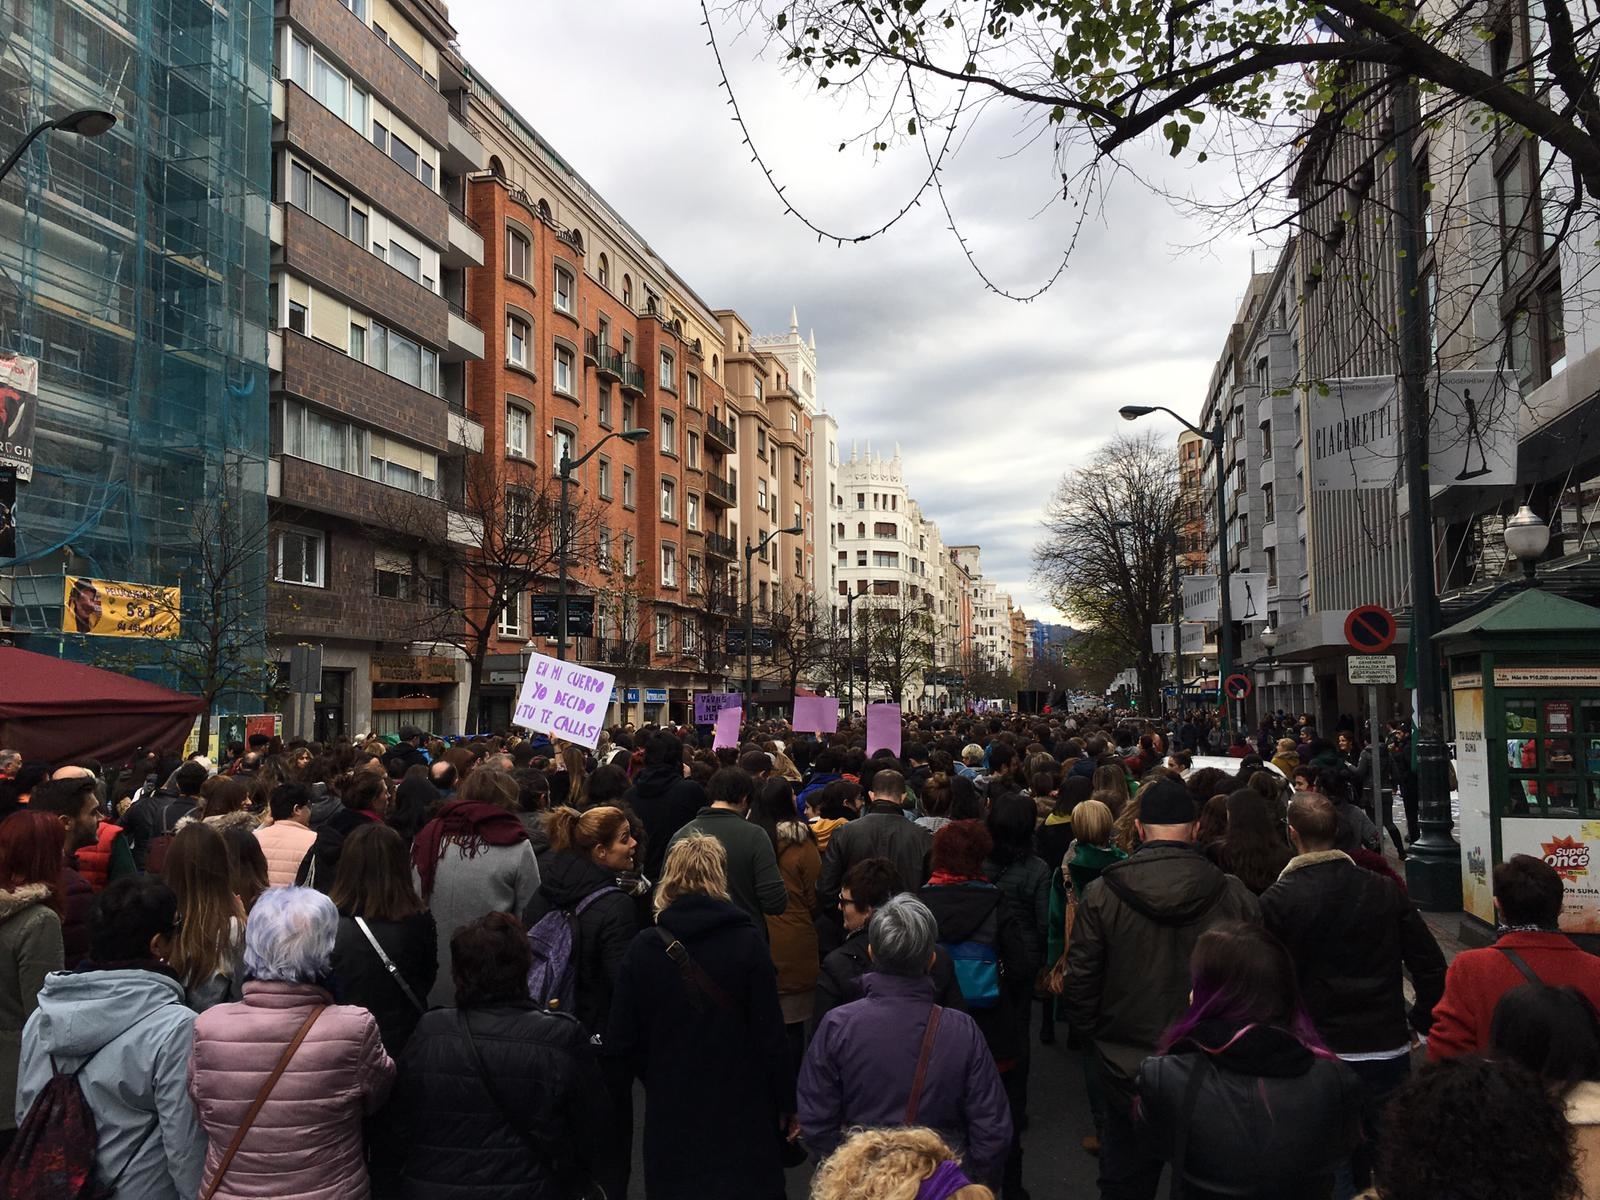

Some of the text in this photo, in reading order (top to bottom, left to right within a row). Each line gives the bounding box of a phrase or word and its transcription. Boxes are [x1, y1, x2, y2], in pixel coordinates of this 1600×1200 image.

[1315, 405, 1391, 460] GIACOMETTI
[535, 661, 605, 693] EN MI CUERPO
[531, 681, 548, 700] YO
[554, 689, 596, 715] DECIDO
[540, 708, 553, 724] TE
[553, 715, 601, 745] CALLAS!
[1544, 854, 1589, 868] Once
[1556, 847, 1588, 858] Super
